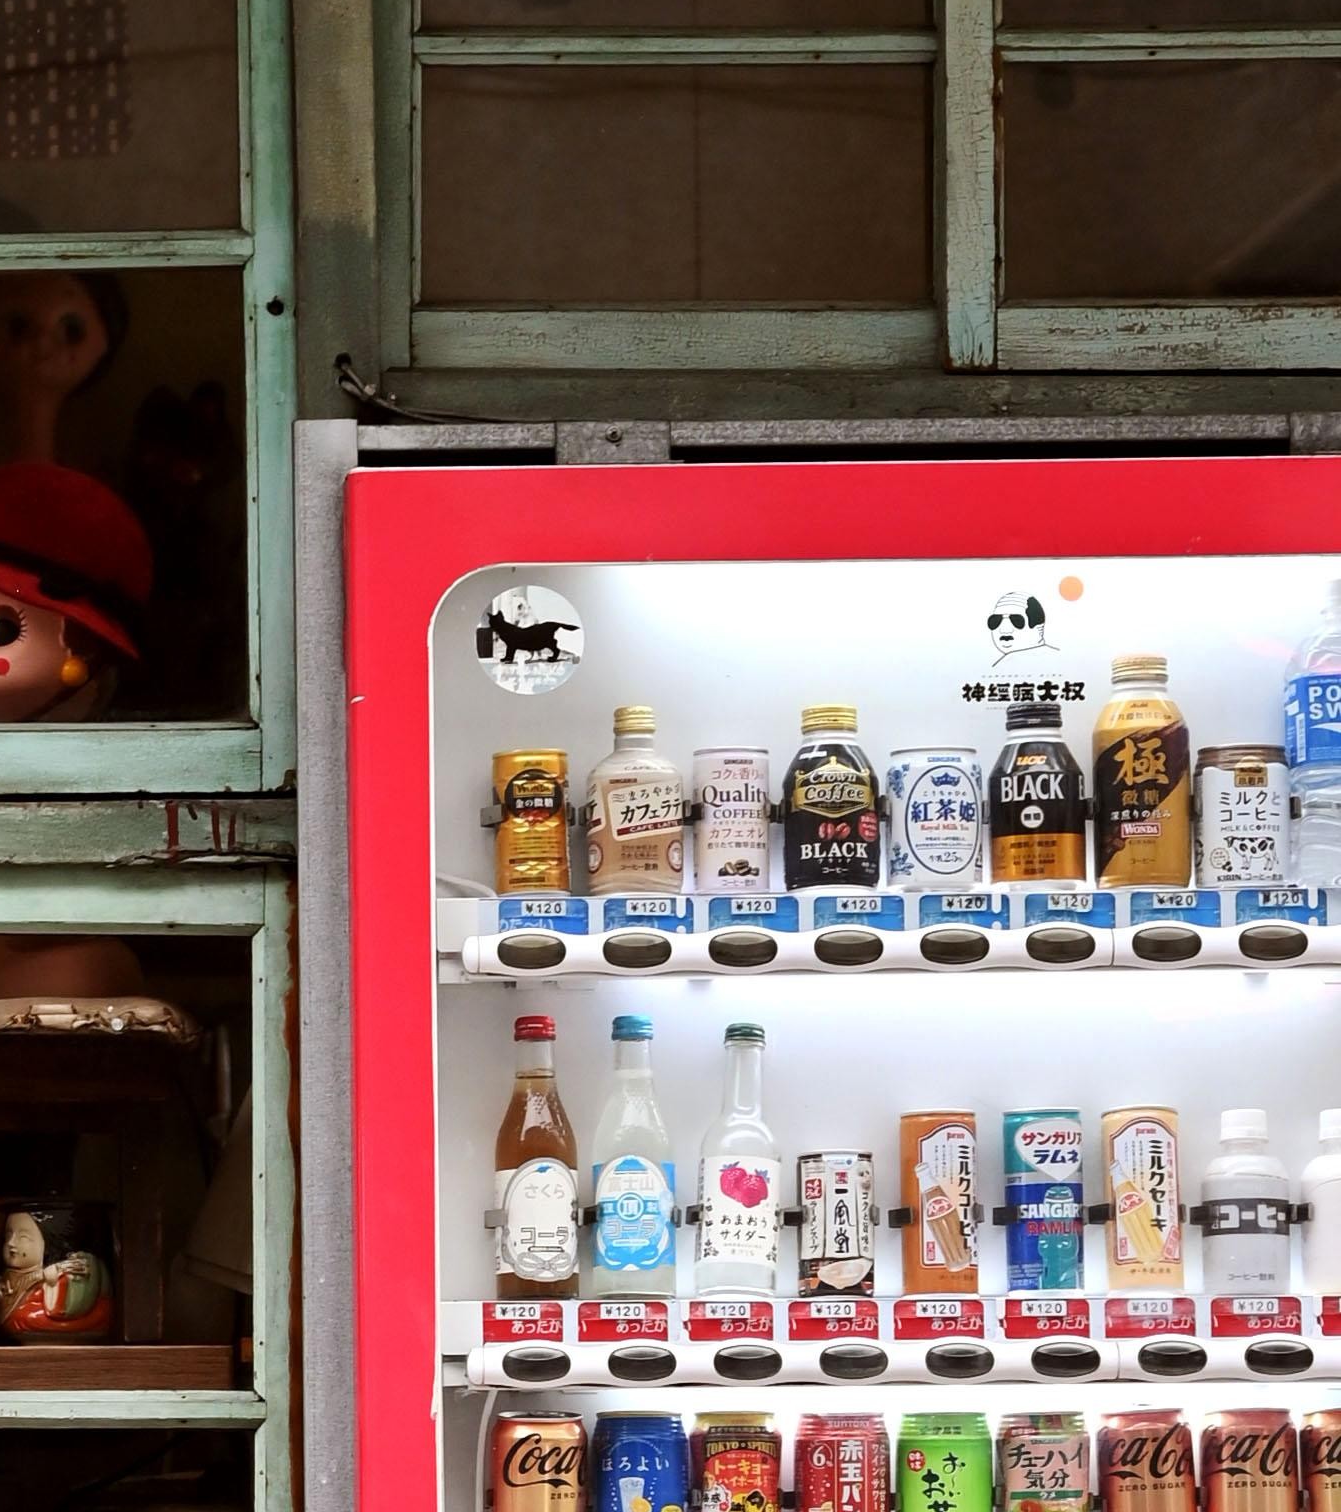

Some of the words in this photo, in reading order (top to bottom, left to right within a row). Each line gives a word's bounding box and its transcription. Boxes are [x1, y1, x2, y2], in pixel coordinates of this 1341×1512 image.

[804, 785, 865, 803] Coffee
[1001, 774, 1065, 803] BLACK
[1219, 791, 1281, 806] ミルクと
[713, 809, 763, 819] COFFEE
[911, 799, 976, 823] 紅茶姫
[1219, 809, 1281, 823] コーヒー
[800, 842, 869, 860] BLACK
[1033, 1149, 1079, 1165] ラムネ
[1148, 1139, 1167, 1233] ミルクセーキ
[520, 1226, 568, 1244] コーラ
[602, 1455, 670, 1472] ほろよい
[1008, 1443, 1084, 1470] チューハイ
[1024, 1469, 1069, 1489] 気分
